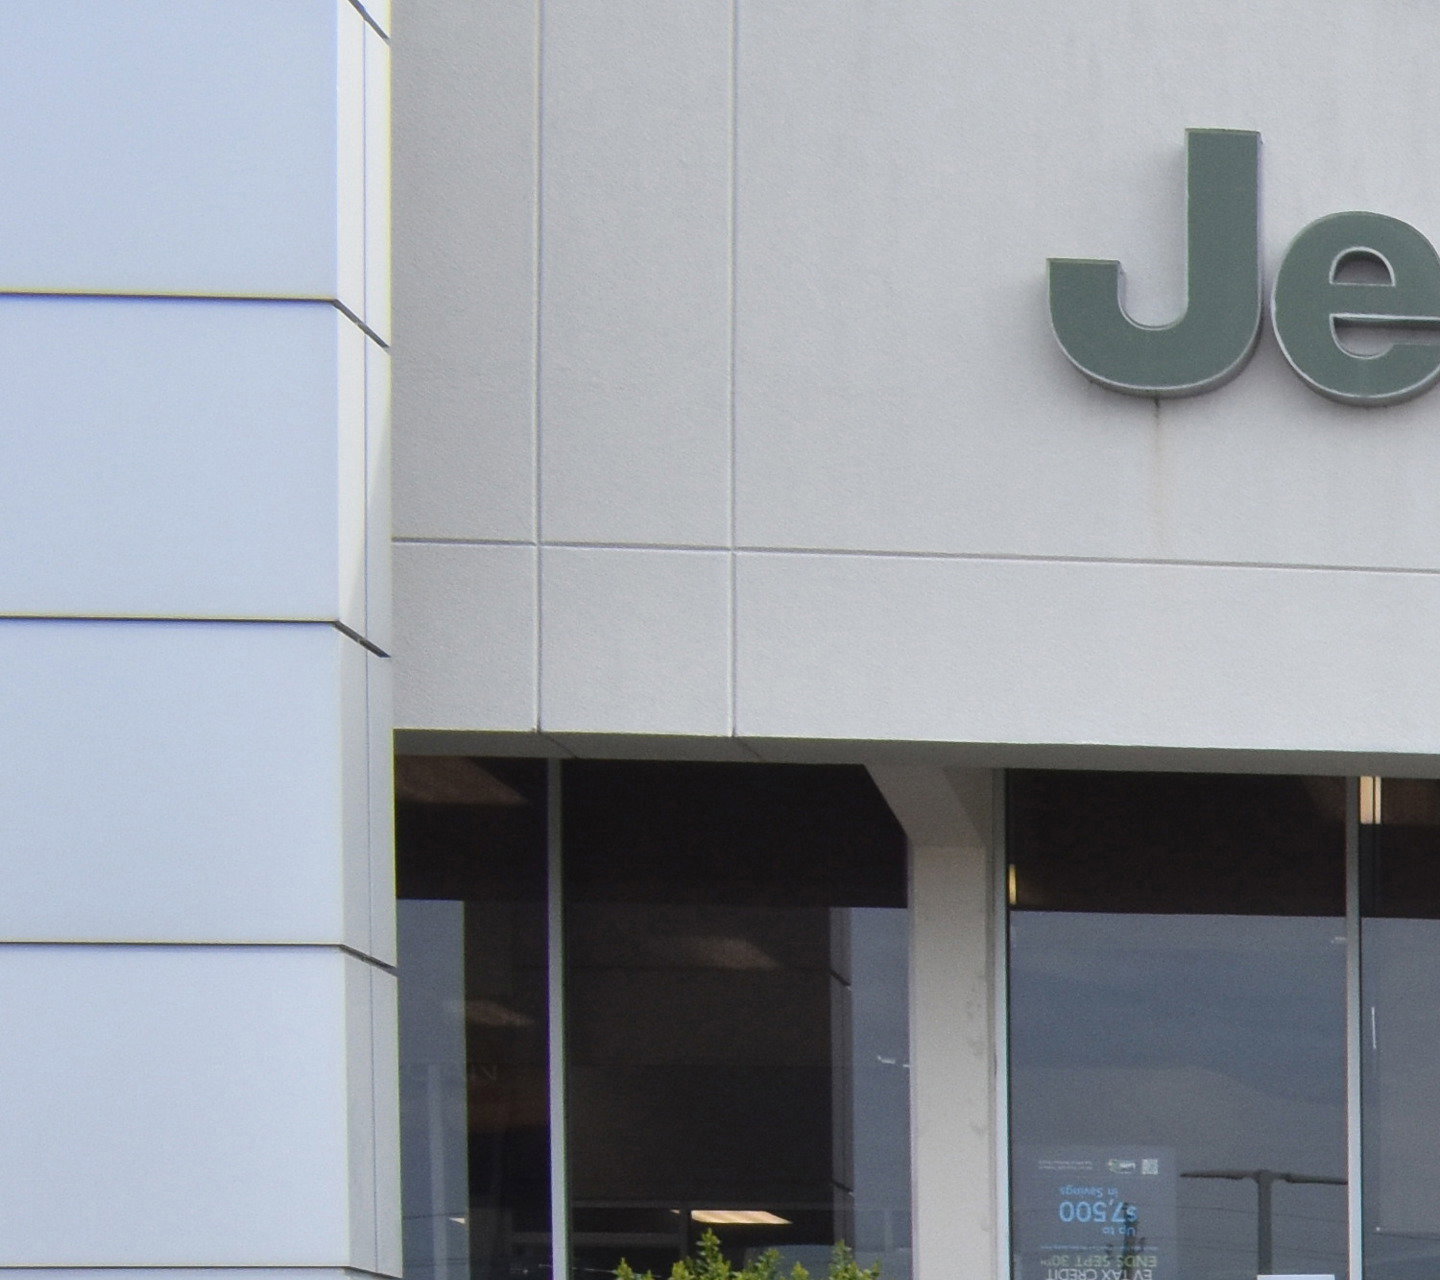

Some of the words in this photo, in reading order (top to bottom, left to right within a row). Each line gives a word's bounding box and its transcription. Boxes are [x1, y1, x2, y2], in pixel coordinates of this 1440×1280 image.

[1059, 1184, 1104, 1198] Savings
[1107, 1186, 1119, 1197] in
[1058, 1199, 1138, 1223] $7,500
[1102, 1225, 1115, 1235] to
[1076, 1255, 1109, 1268] SEPT
[1045, 1268, 1098, 1280] CREDIT
[1102, 1268, 1129, 1280] TAX
[1132, 1268, 1153, 1280] EV
